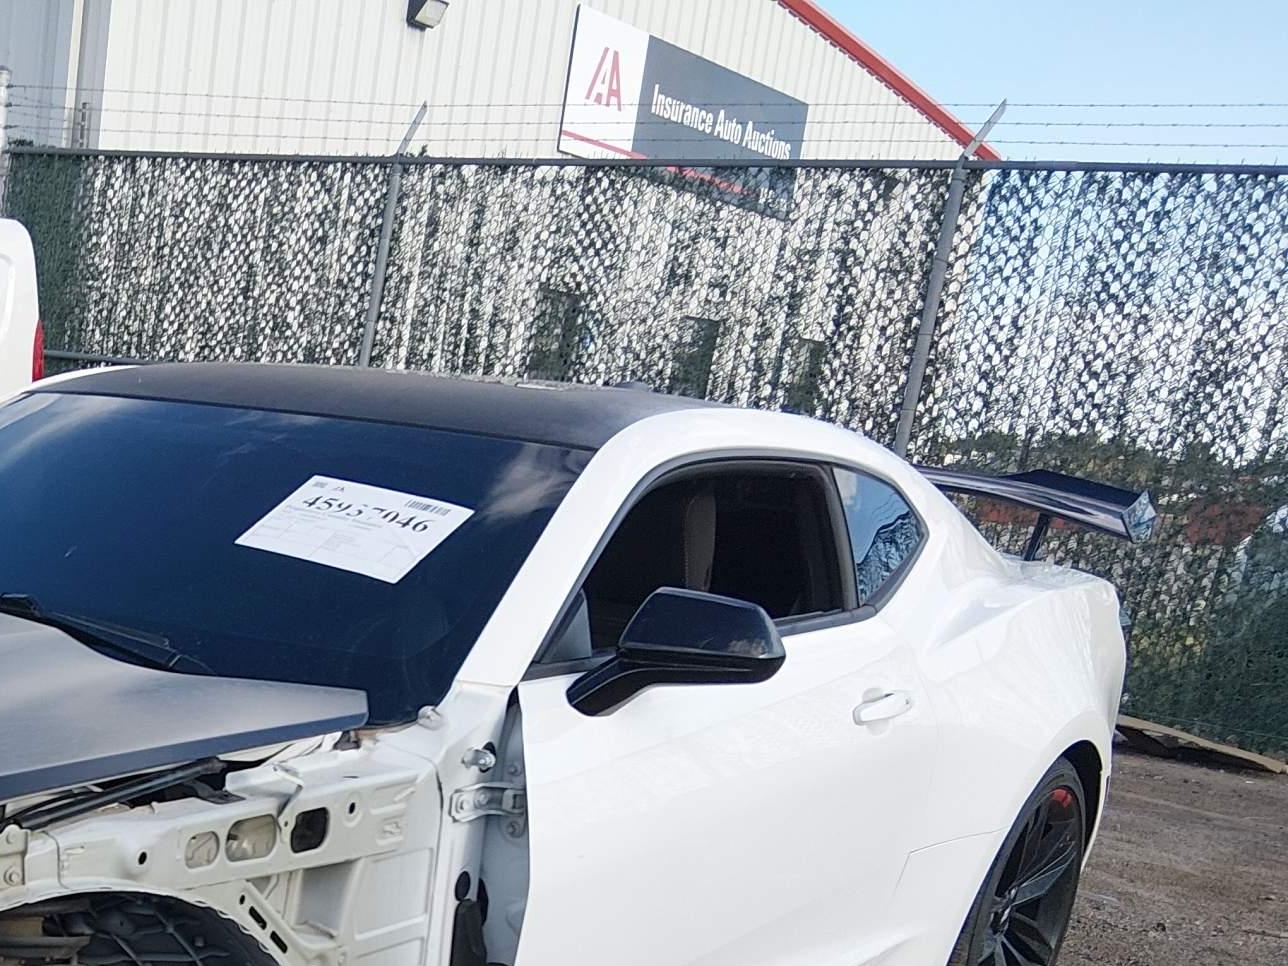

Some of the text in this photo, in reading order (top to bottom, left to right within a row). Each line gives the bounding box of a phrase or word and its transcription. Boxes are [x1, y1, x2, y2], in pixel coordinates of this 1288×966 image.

[651, 84, 791, 160] Insurance Auto Auctions
